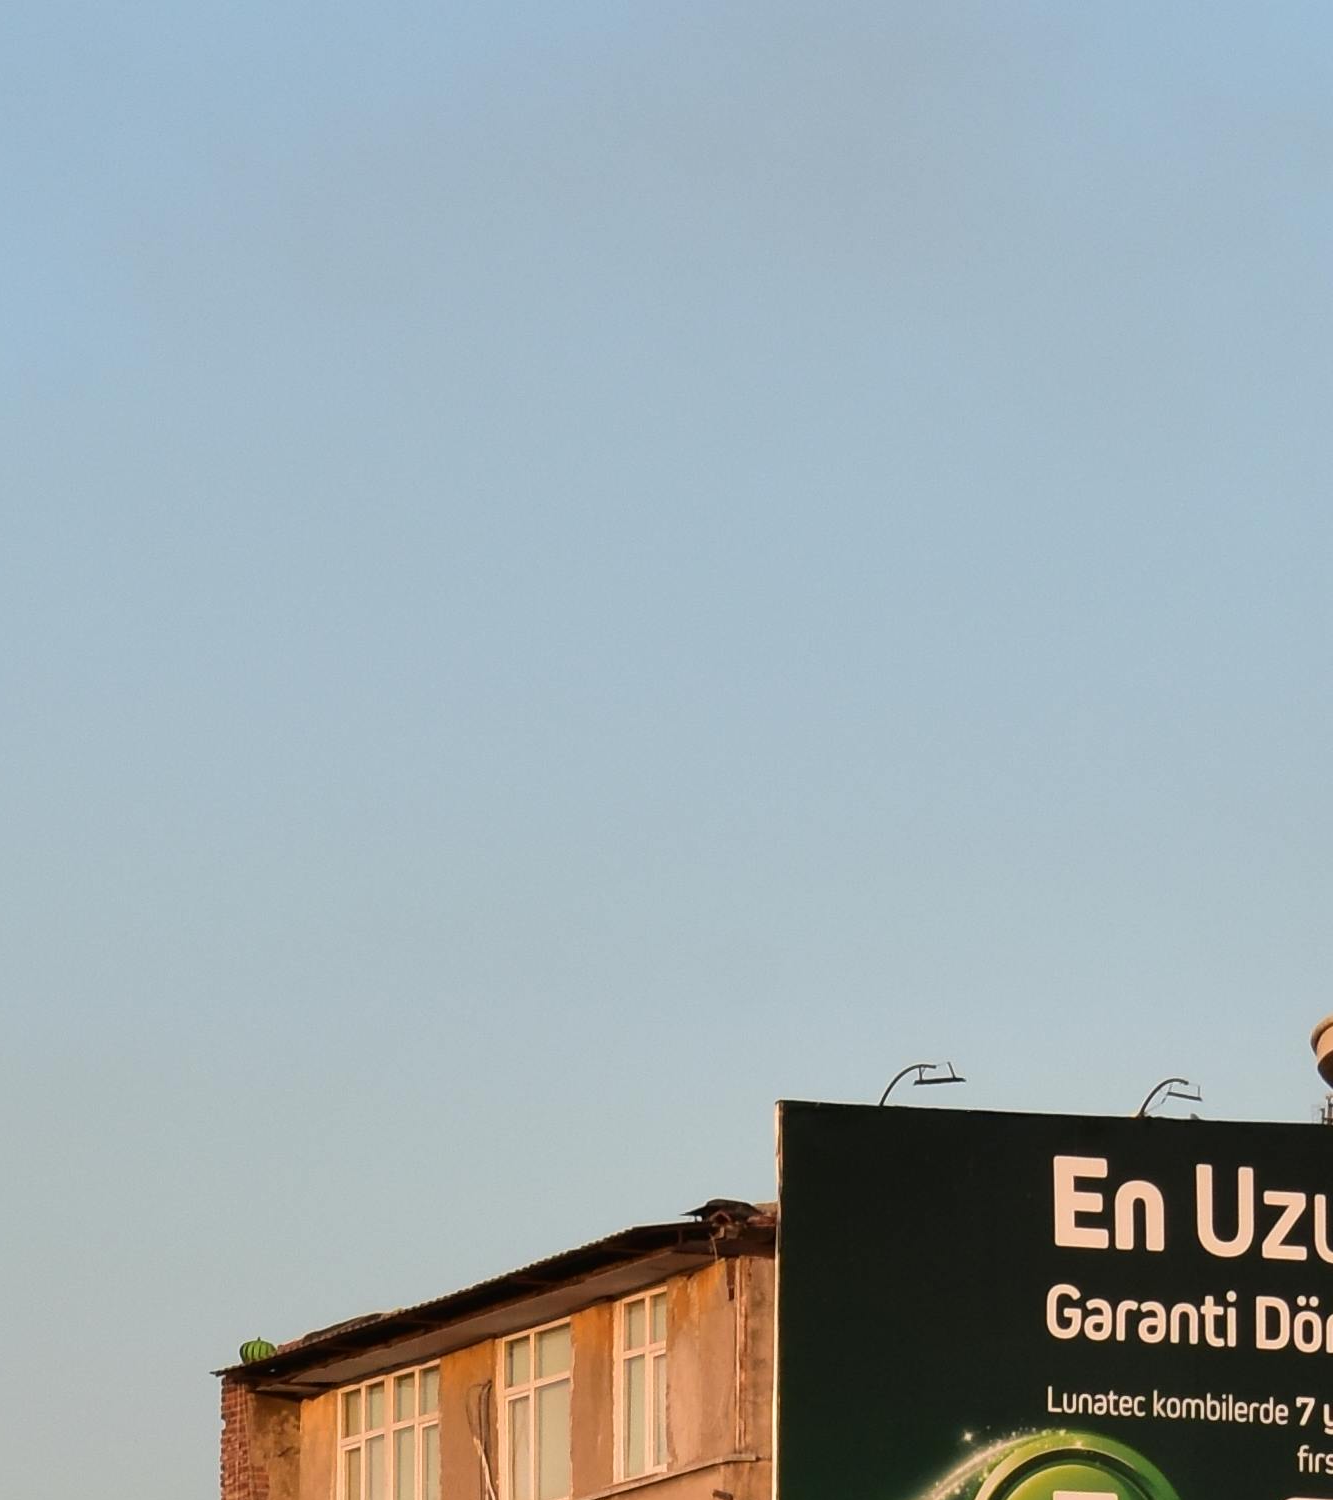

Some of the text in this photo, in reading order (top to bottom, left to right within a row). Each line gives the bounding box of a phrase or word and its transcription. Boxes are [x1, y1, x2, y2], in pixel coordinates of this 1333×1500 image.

[1053, 1155, 1165, 1252] En
[1046, 1283, 1333, 1354] Garanti Dö
[1047, 1385, 1146, 1418] Lunatec
[1152, 1388, 1290, 1426] kombilerde
[1295, 1396, 1316, 1426] 7
